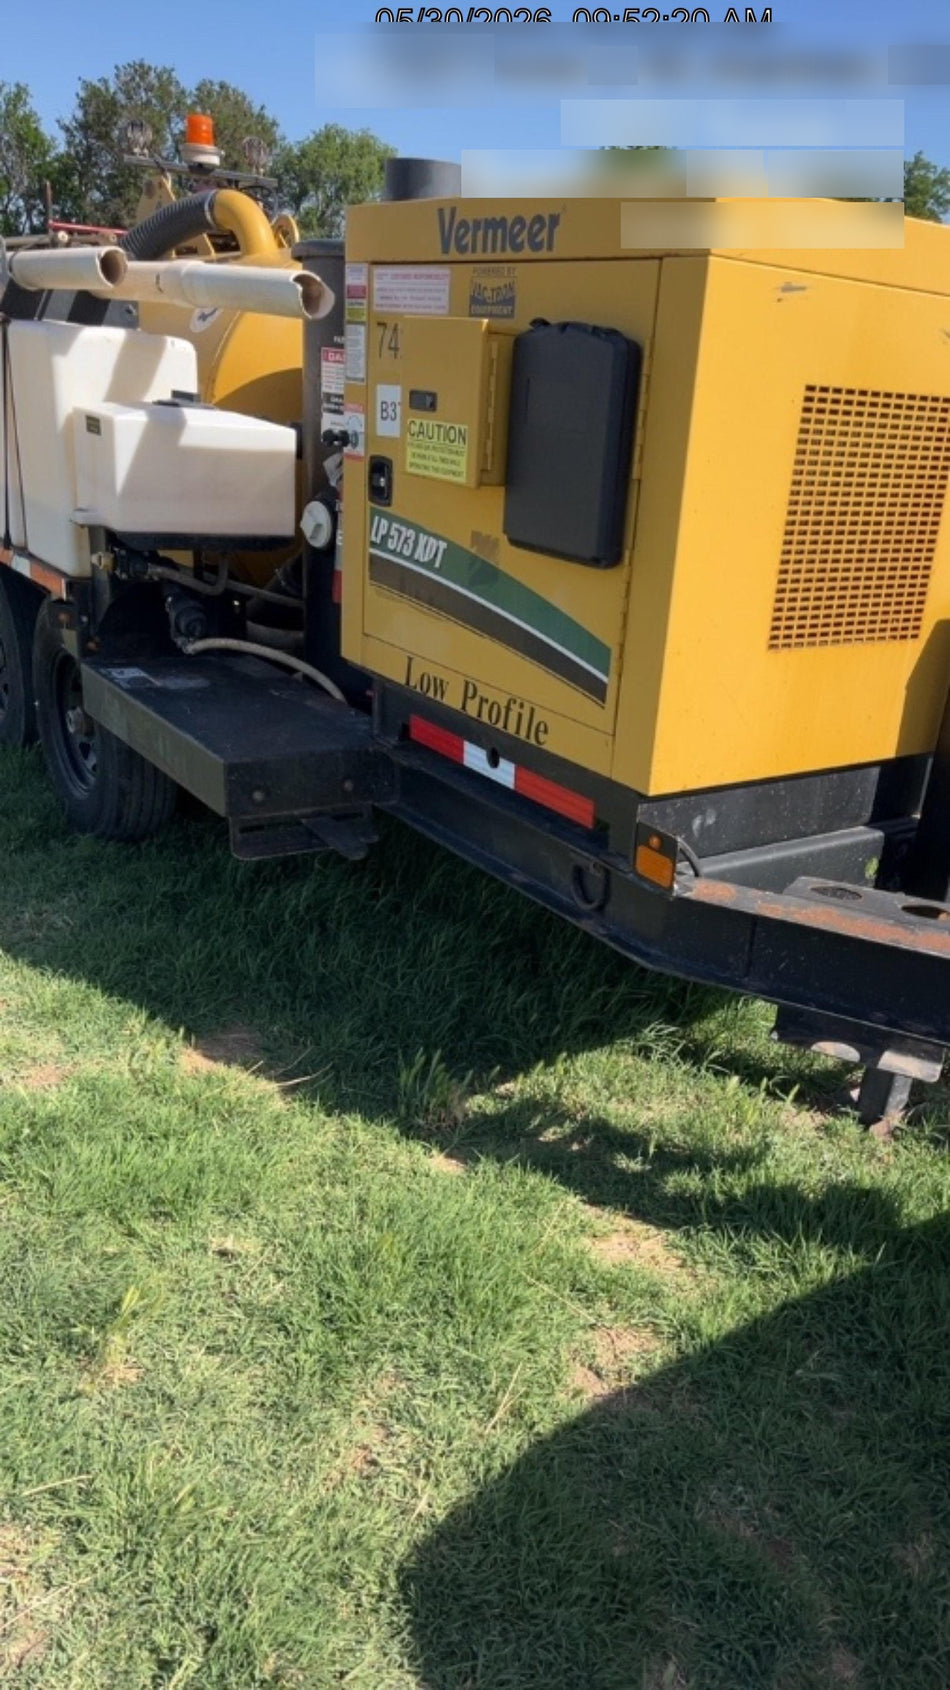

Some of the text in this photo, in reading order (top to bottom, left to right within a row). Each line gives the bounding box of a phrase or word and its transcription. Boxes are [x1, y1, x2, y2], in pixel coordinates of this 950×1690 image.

[437, 206, 560, 254] Vermeer
[381, 401, 401, 421] B3
[408, 420, 467, 446] CAUTION
[370, 515, 388, 544] LP
[387, 522, 416, 556] 573
[404, 656, 549, 746] Low Profile
